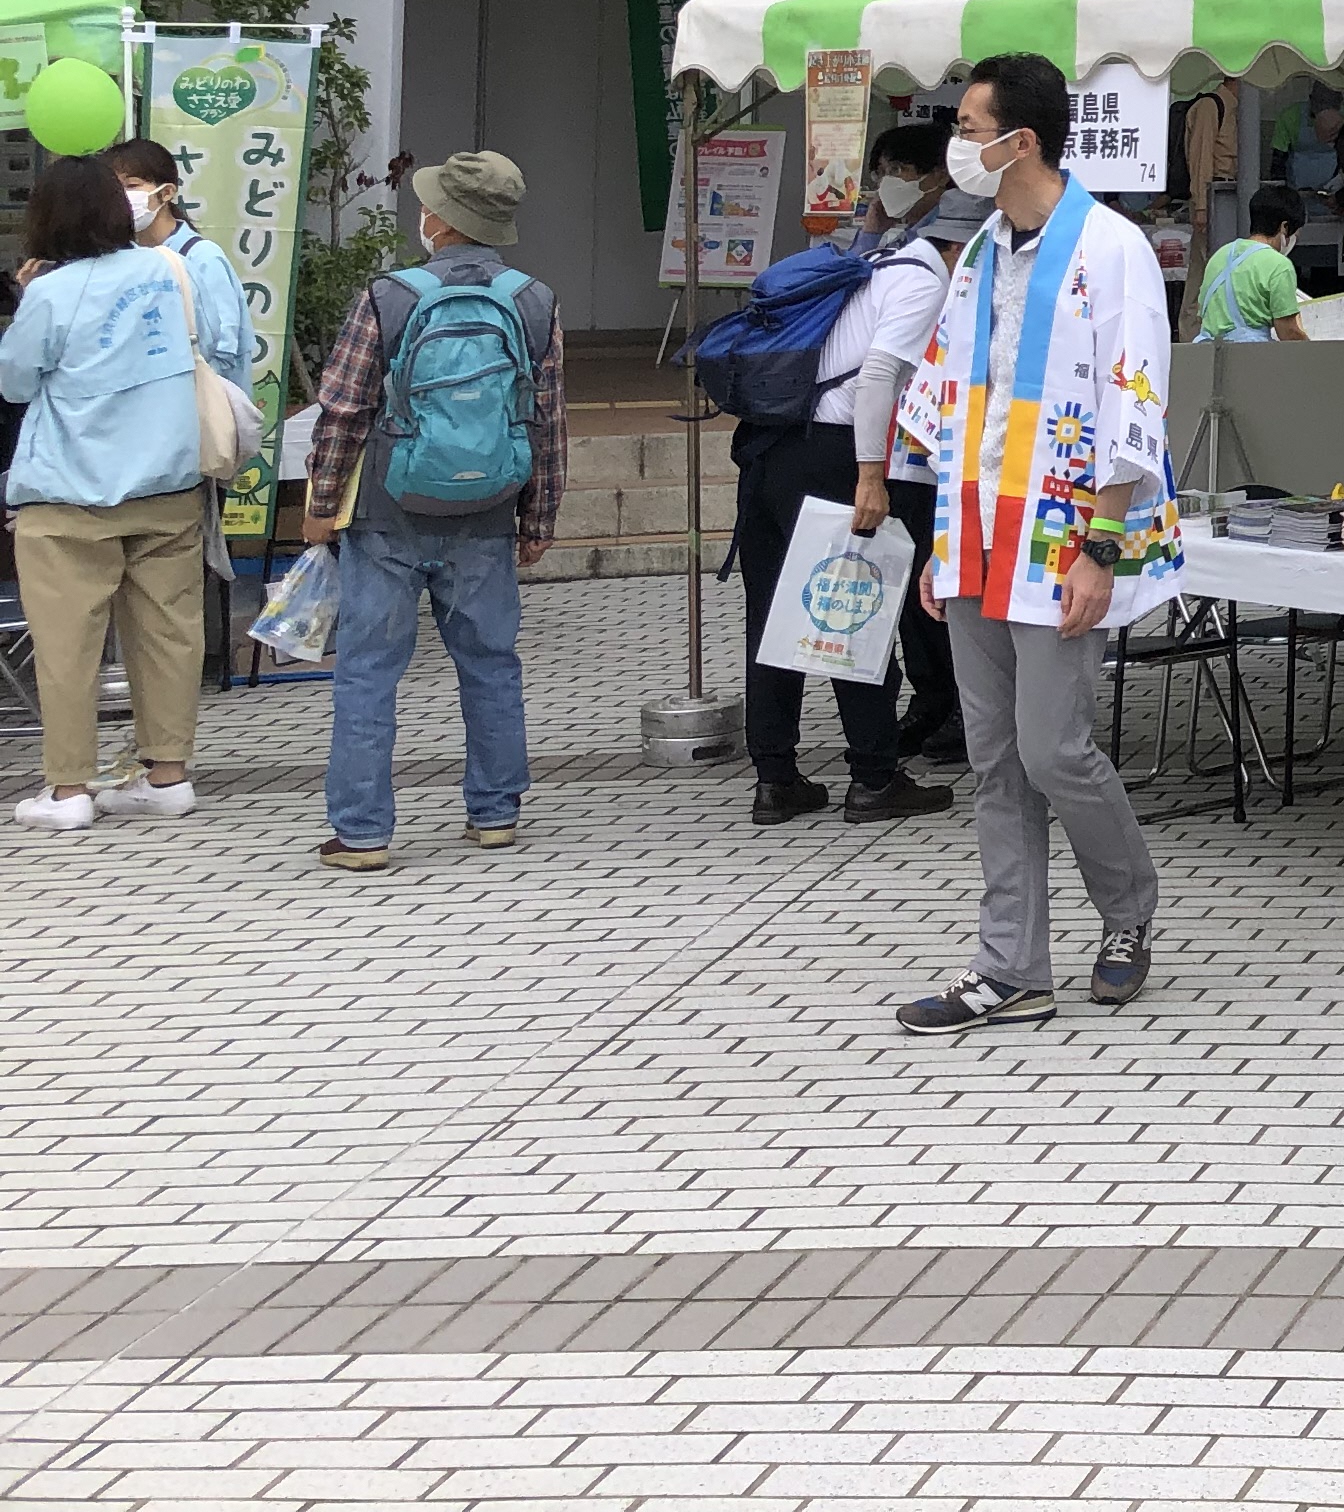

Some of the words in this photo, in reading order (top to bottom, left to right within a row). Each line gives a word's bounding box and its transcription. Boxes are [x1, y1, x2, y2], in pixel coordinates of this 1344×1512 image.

[179, 75, 251, 90] みどりのわ
[199, 109, 227, 119] プラン
[1140, 162, 1156, 183] 74
[1074, 361, 1091, 380] 福
